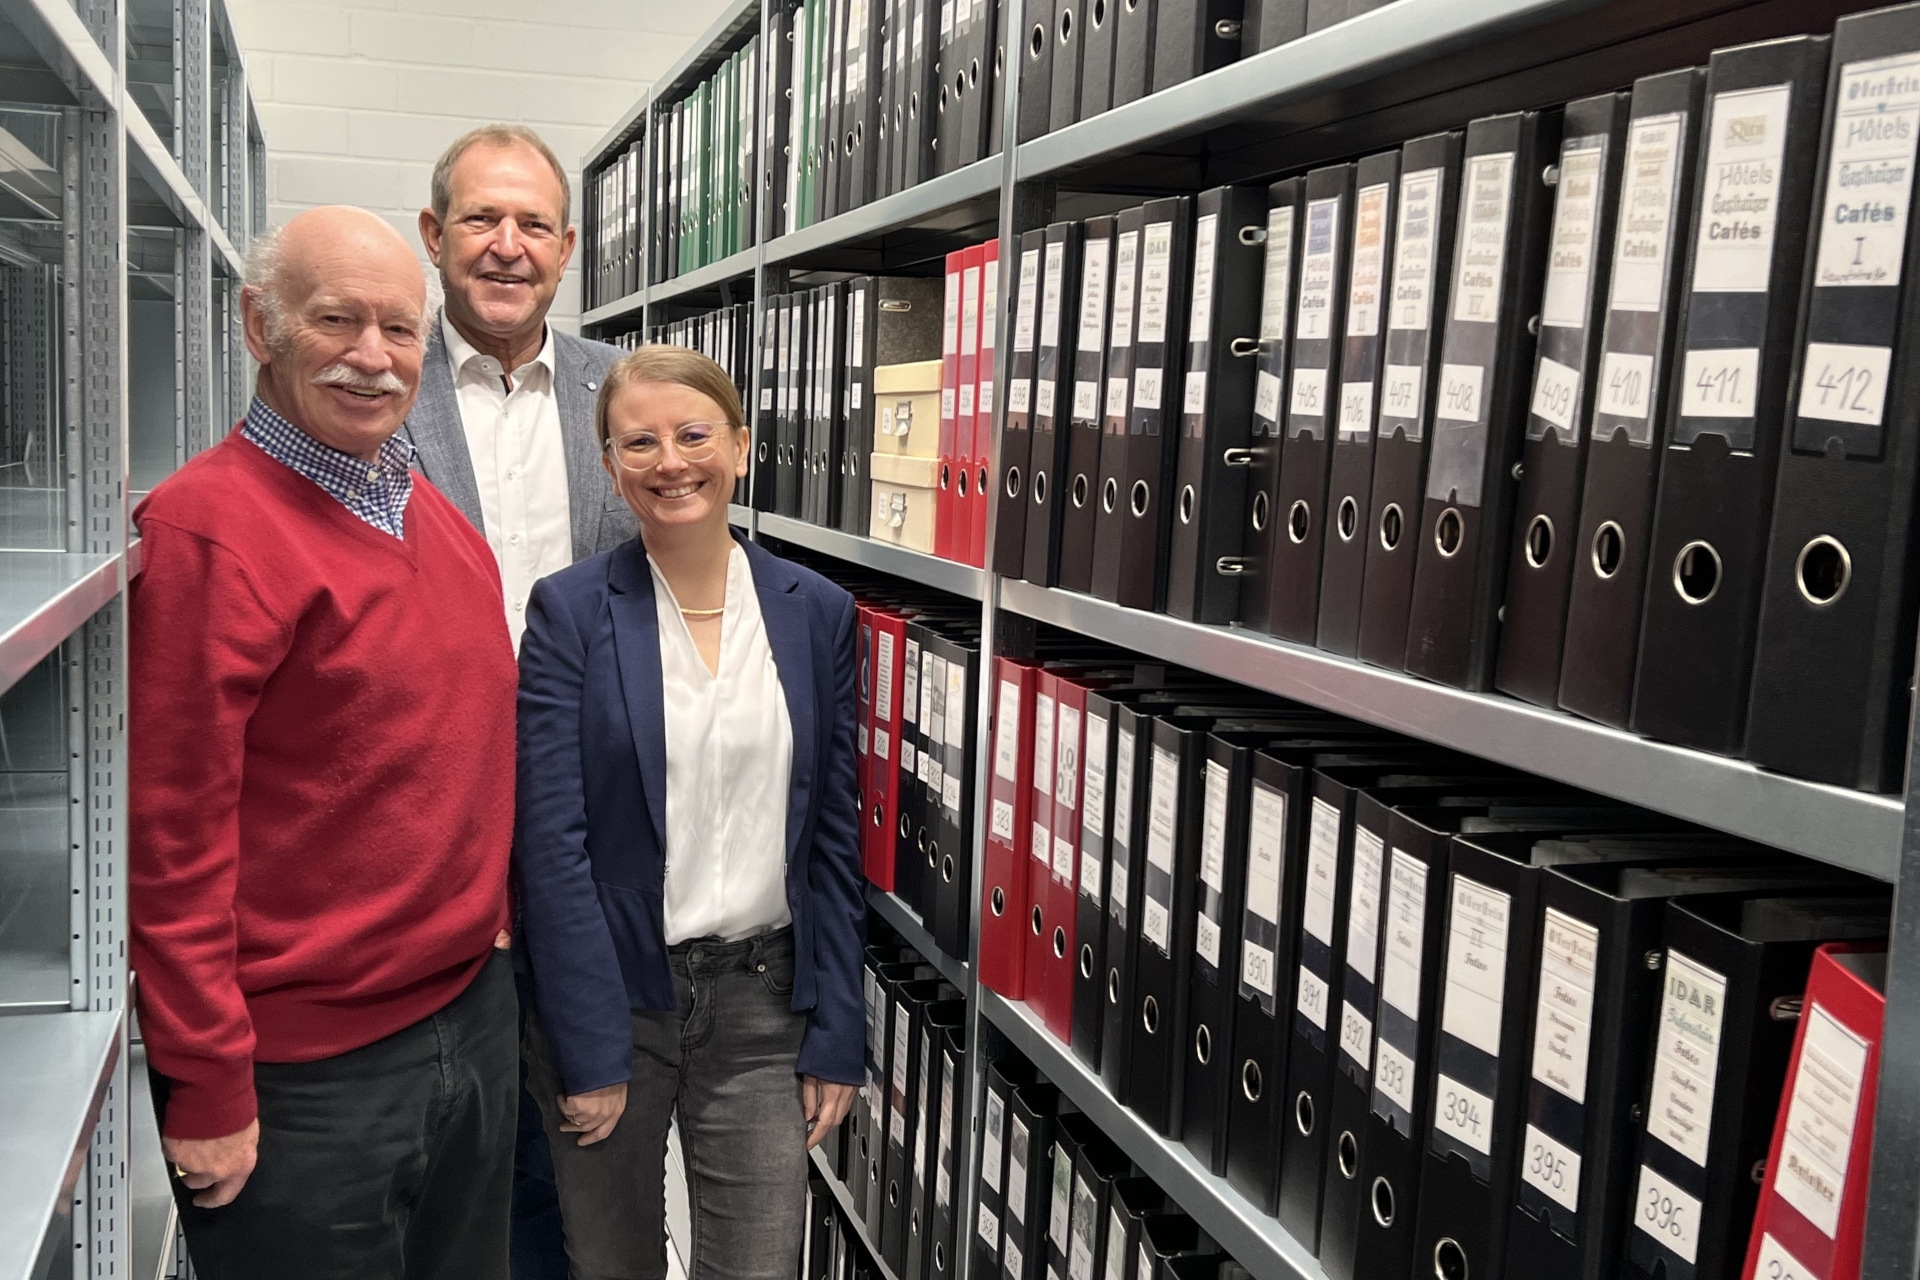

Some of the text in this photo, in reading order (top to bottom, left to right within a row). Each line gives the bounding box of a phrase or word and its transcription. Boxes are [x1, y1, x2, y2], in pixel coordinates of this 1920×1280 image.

[1846, 117, 1911, 148] Hôtels
[1717, 164, 1774, 191] Hôtels
[1835, 202, 1895, 224] Cafés
[1709, 222, 1761, 240] Cafés
[1624, 240, 1657, 257] Cafés
[1553, 252, 1582, 268] Cafés
[1463, 271, 1494, 288] Cafés
[1397, 285, 1421, 300] Cafés
[1302, 295, 1326, 309] Cafés
[995, 806, 1011, 832] 383
[1670, 977, 1715, 1016] IDAR
